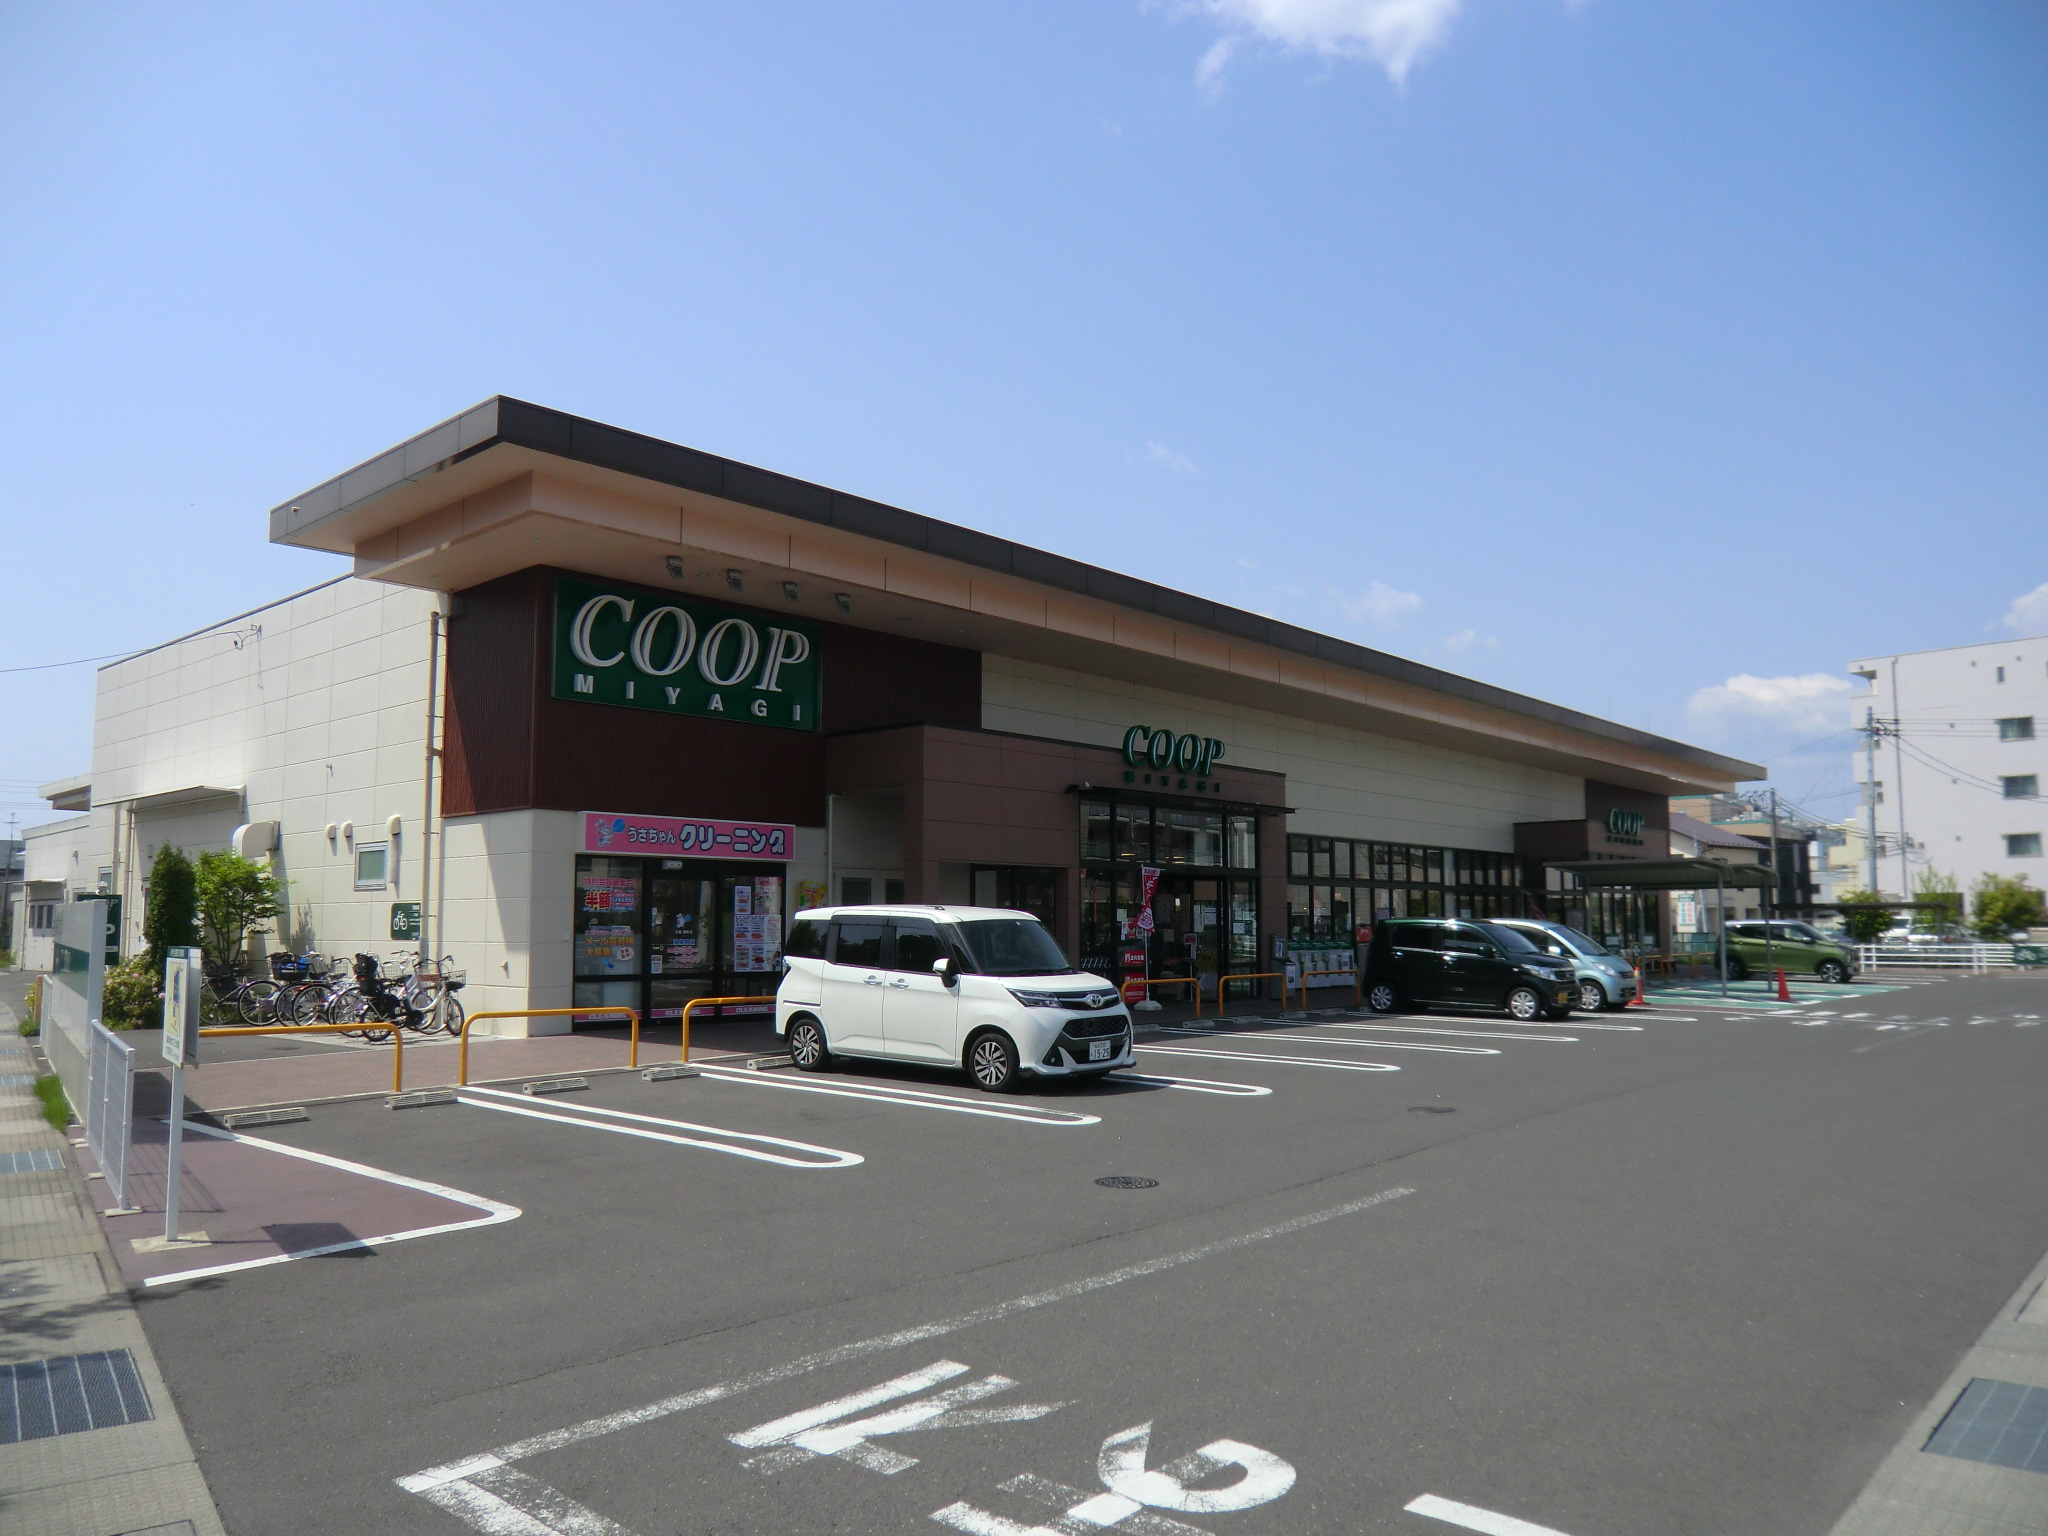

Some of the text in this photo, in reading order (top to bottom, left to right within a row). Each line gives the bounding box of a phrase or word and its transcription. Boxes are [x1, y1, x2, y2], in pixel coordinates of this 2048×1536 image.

[570, 594, 810, 693] COOP
[573, 673, 801, 722] MIYAGI
[1123, 725, 1225, 775] COOP
[627, 824, 785, 855] うさちゃん クリーニング
[584, 890, 611, 909] 半額
